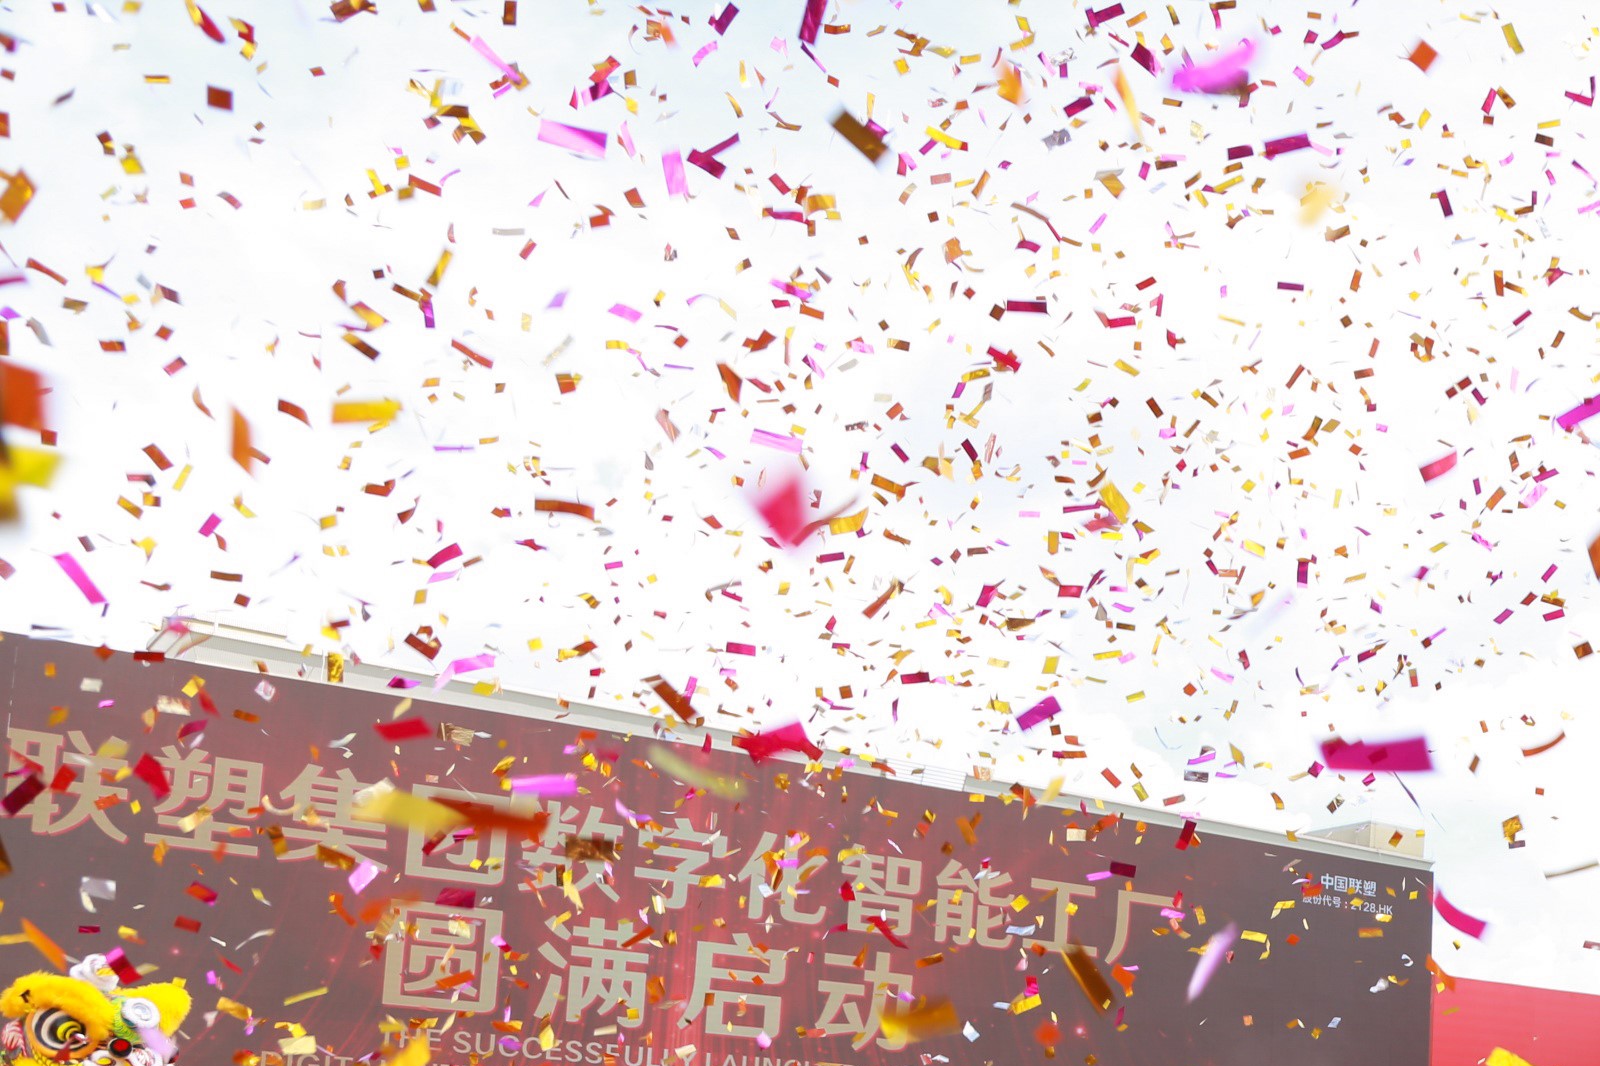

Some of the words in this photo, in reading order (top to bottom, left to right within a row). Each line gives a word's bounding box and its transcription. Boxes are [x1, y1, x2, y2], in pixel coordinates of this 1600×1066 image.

[1321, 873, 1377, 898] 中国联塑
[381, 897, 914, 1052] 圆满启动
